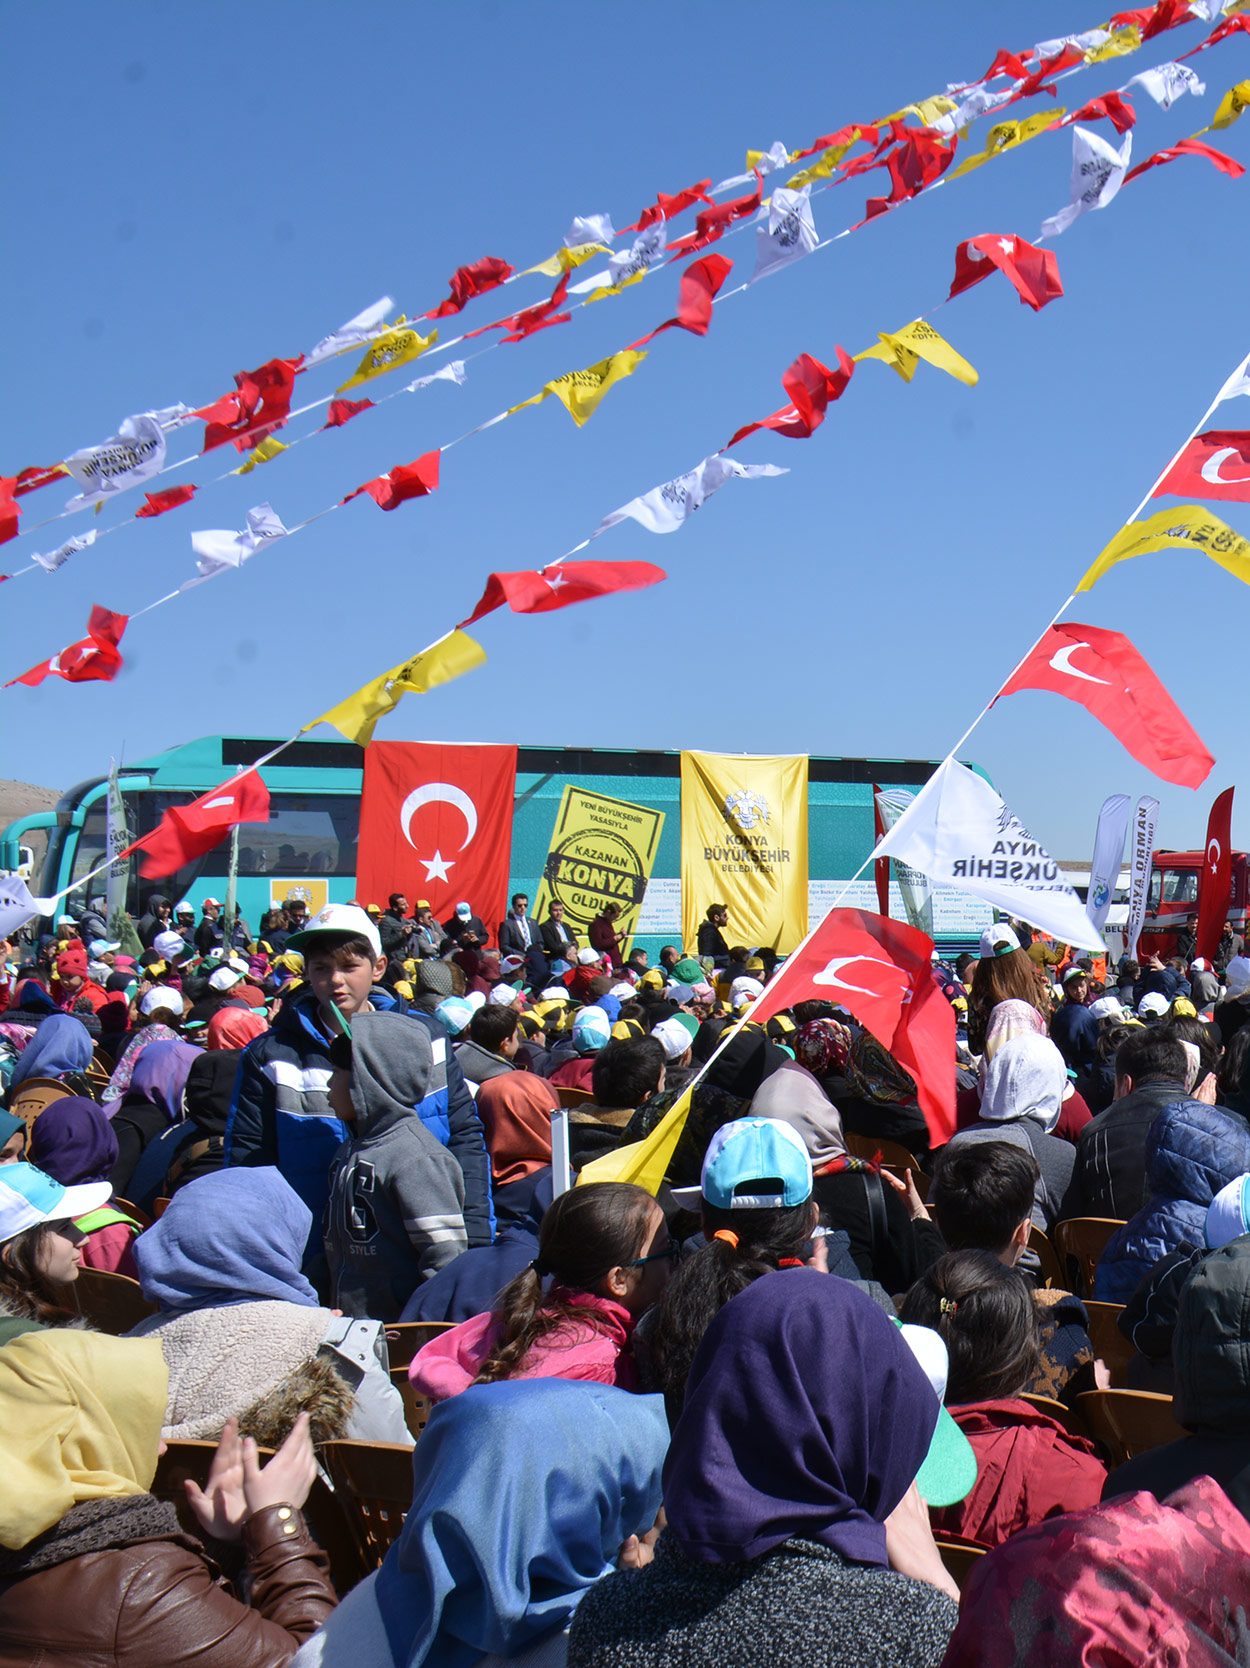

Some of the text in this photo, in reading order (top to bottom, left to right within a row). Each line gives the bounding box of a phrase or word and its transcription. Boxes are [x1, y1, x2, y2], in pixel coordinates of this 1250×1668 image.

[580, 800, 643, 824] YENİ BÜYÜKŞEHİR
[589, 814, 629, 831] YASASIYLA
[726, 834, 769, 846] KONYA
[1134, 806, 1147, 872] ORMAN
[575, 845, 629, 868] KAZANAN
[704, 845, 791, 863] BÜYÜKŞEHİR
[722, 864, 774, 873] BELEDİYESİ
[557, 860, 634, 898] KONYA
[344, 1159, 380, 1244] 6
[349, 1245, 378, 1256] STYLE
